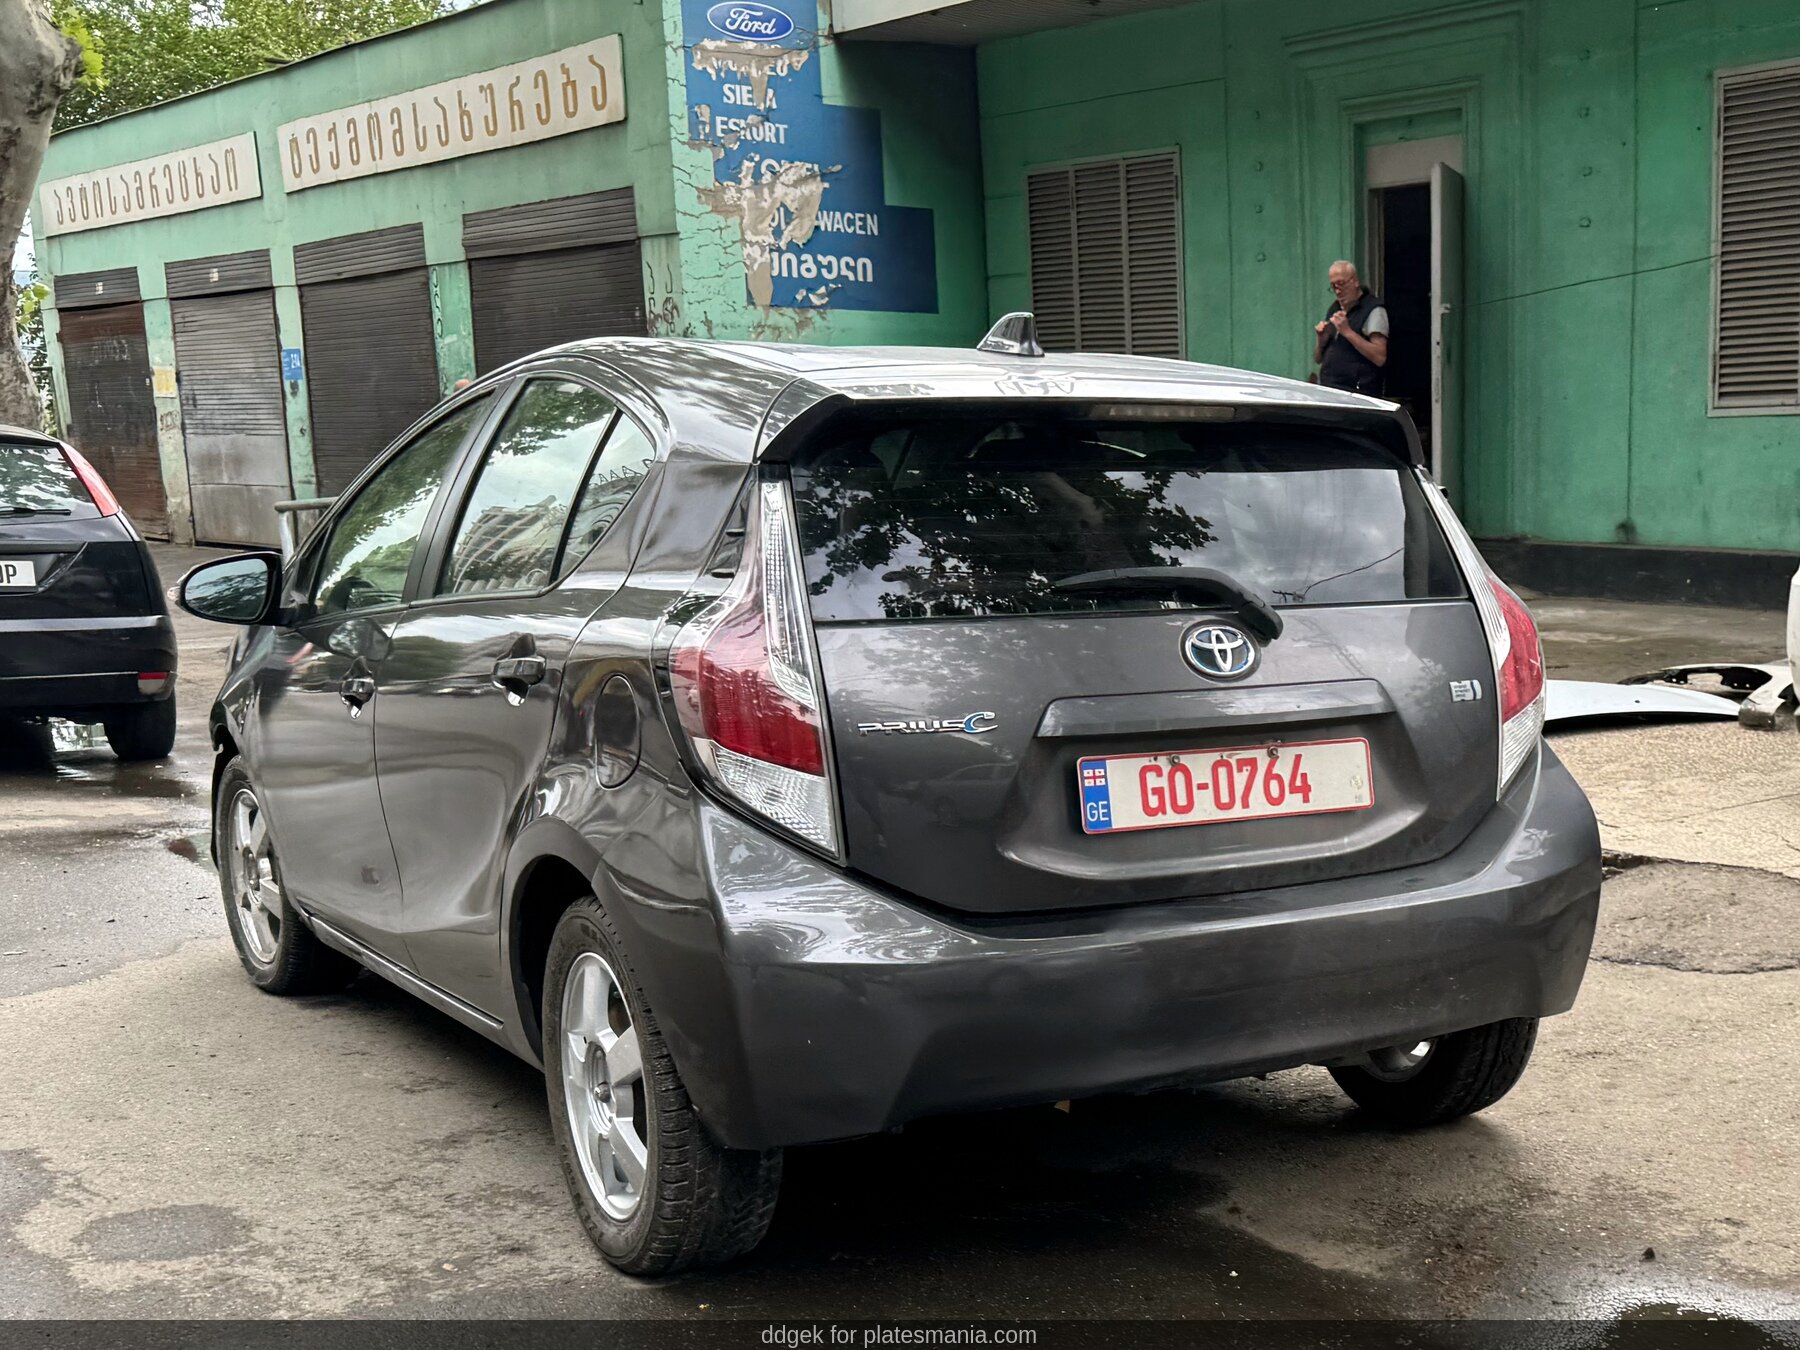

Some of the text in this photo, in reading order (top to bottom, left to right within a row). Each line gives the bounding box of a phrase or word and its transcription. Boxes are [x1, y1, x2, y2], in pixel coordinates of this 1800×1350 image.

[725, 7, 777, 35] Ford
[288, 54, 607, 178] ტექმომსახურება
[54, 147, 239, 225] ავტოსამრეცხაო
[0, 564, 17, 584] P
[1138, 753, 1312, 818] GO-0764
[1086, 802, 1110, 822] GE
